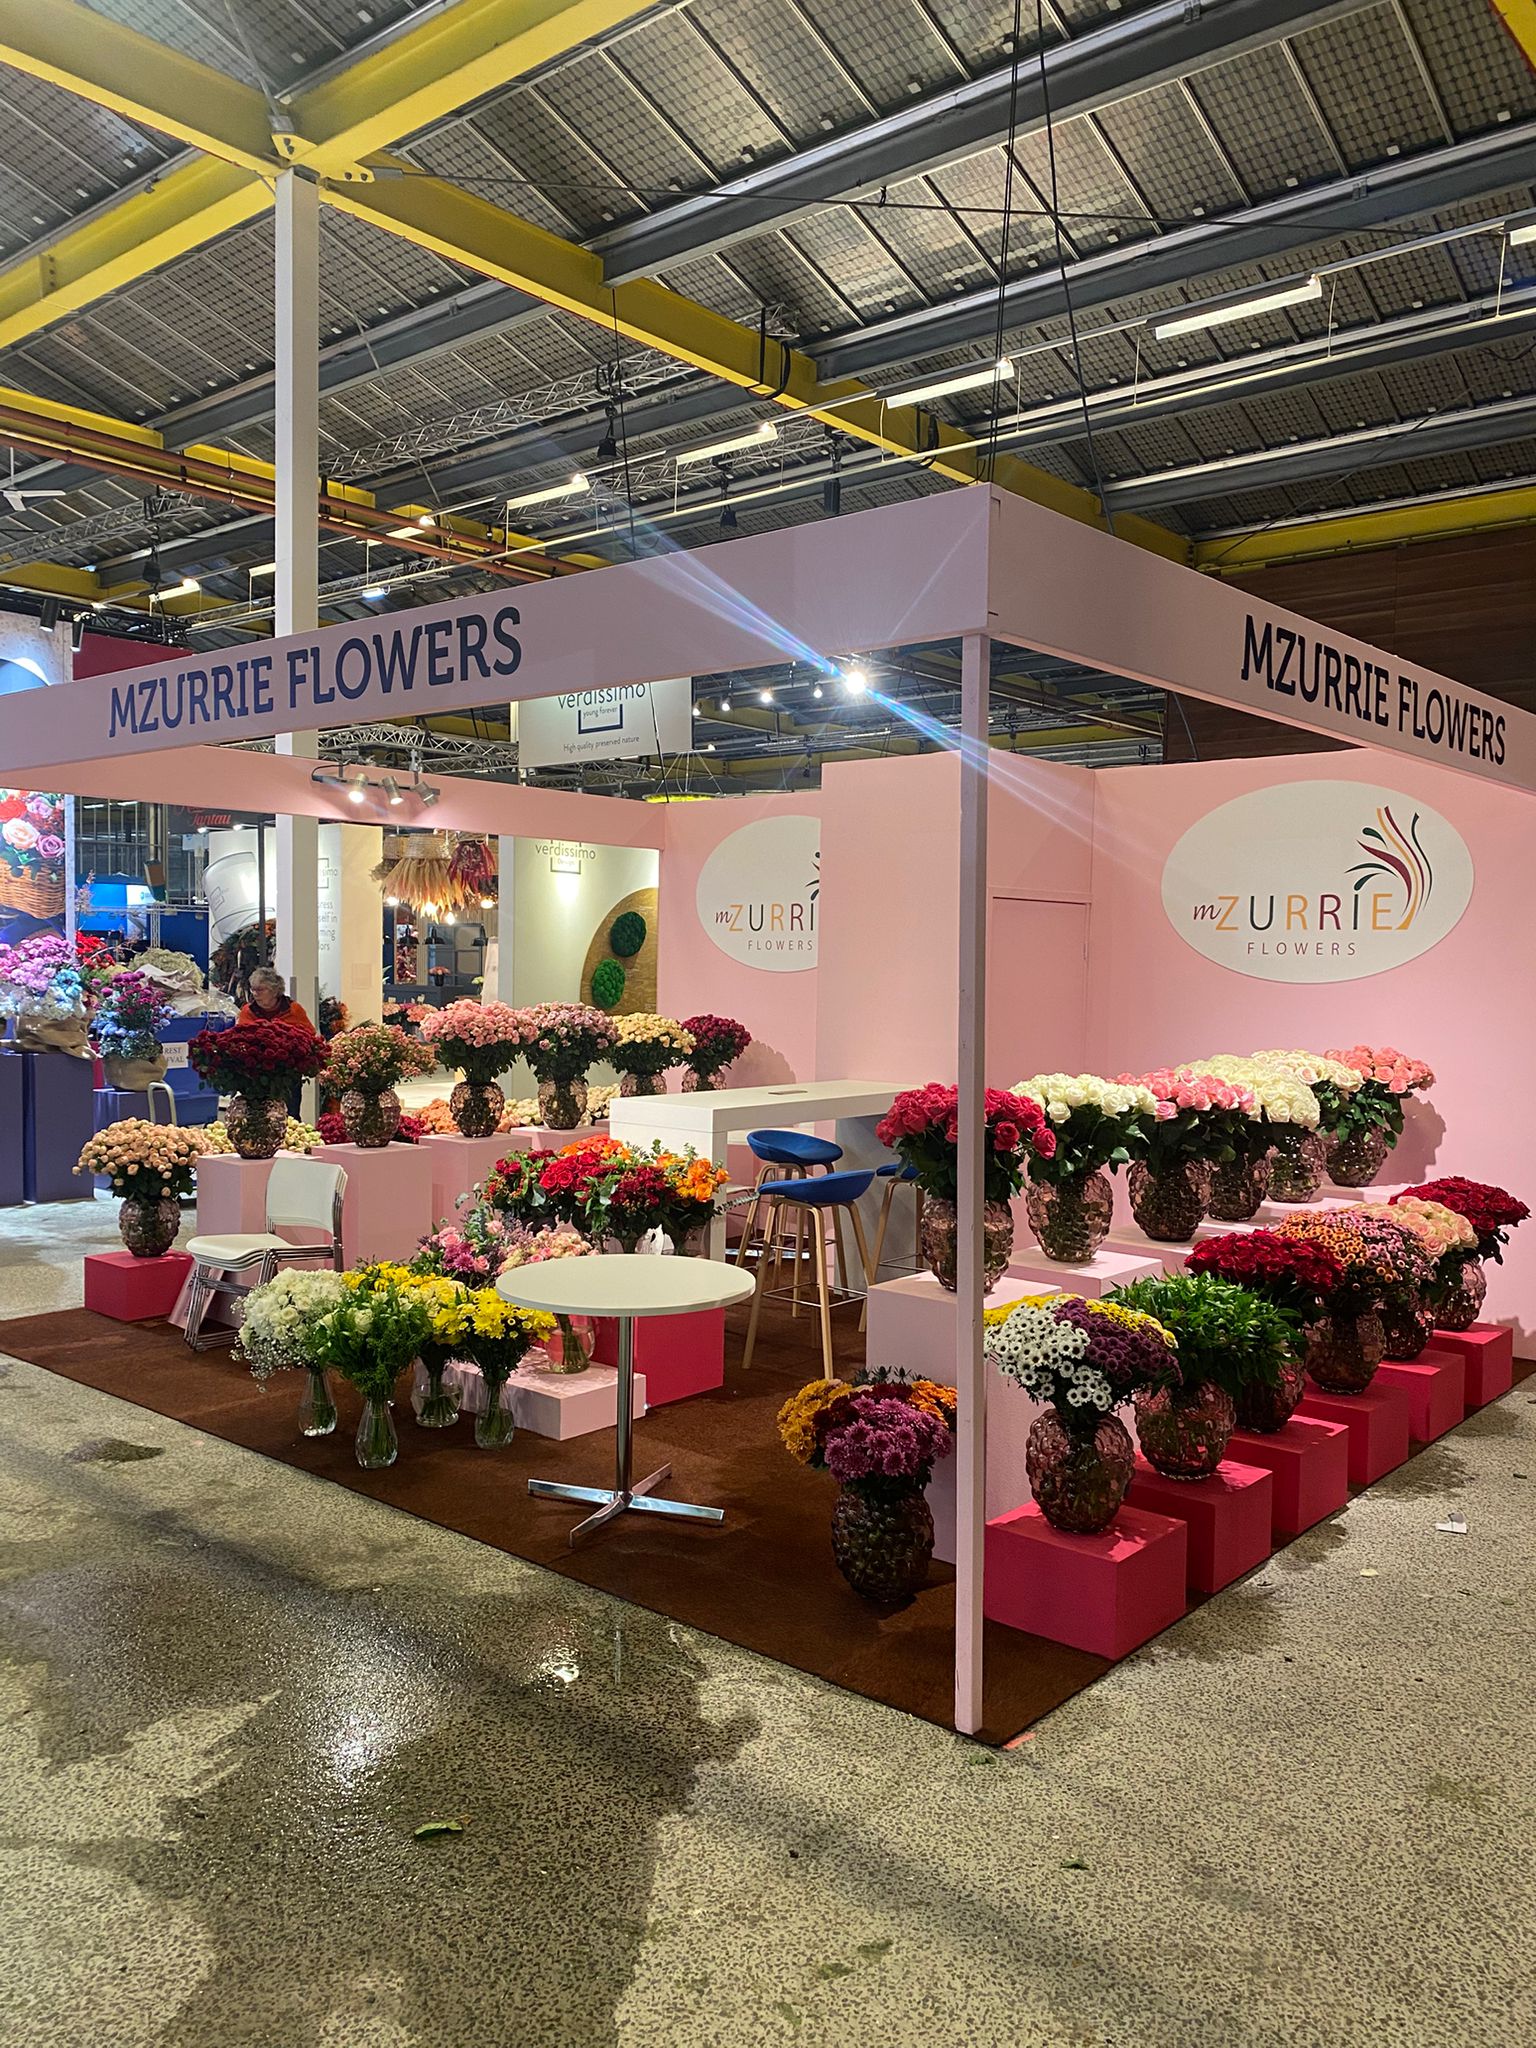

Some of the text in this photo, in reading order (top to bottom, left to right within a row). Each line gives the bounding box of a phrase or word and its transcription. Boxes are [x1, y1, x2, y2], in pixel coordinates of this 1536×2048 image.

[109, 606, 522, 737] MZURRIE FLOWERS
[558, 683, 646, 709] verdissimo
[1241, 614, 1506, 765] MZURRIE FLOWERS
[583, 706, 618, 718] young forever
[563, 735, 639, 754] High quality preserved nature
[535, 842, 596, 860] verdissimo
[715, 903, 814, 932] mZURRI
[748, 939, 813, 951] FLOWERS
[1247, 941, 1356, 956] FLOWERS
[164, 1046, 182, 1055] REST
